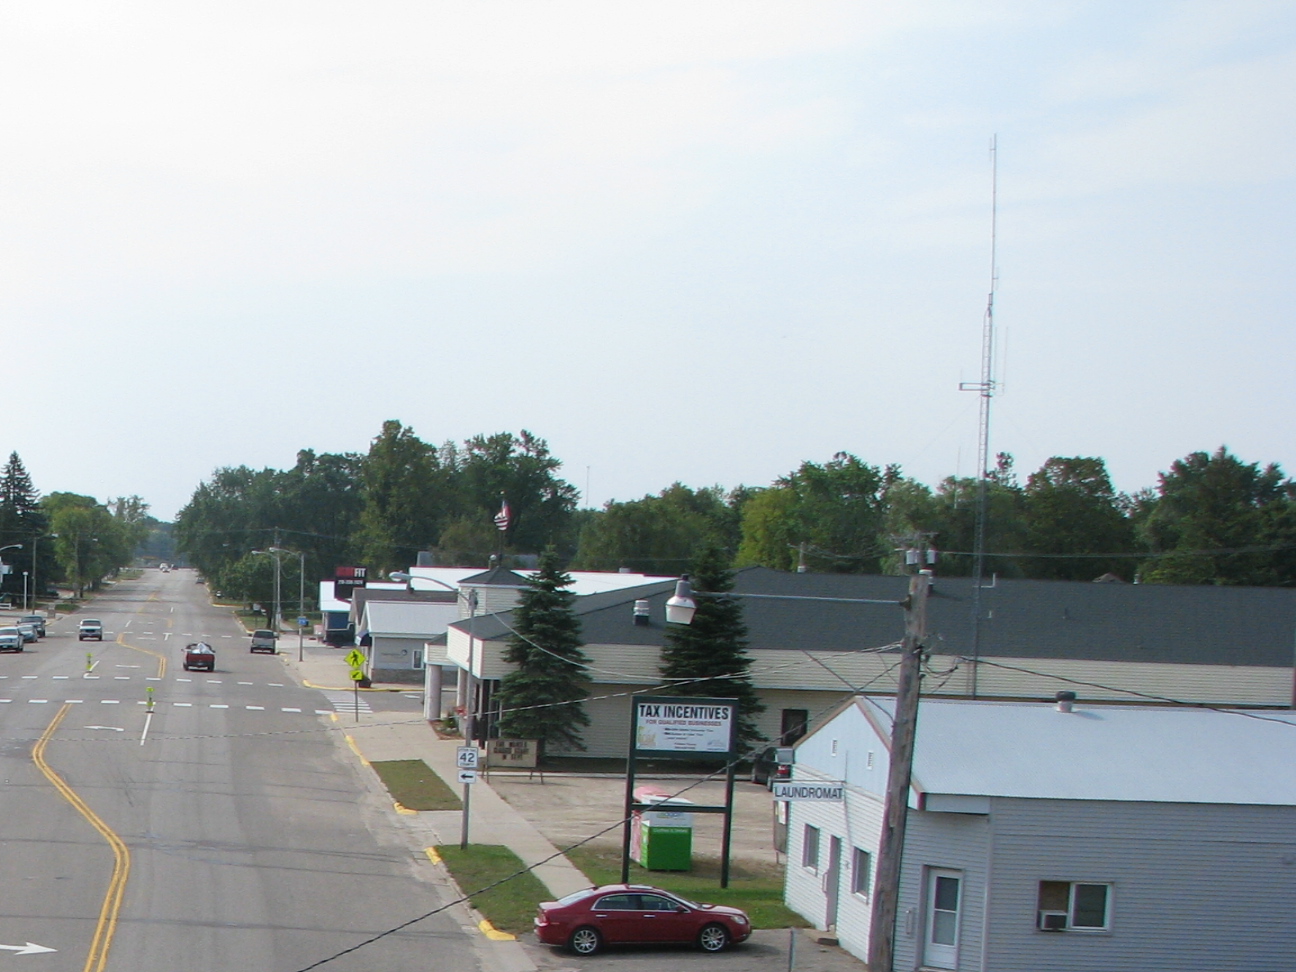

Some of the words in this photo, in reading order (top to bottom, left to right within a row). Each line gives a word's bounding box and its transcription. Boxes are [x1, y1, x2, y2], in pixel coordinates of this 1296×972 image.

[640, 704, 660, 718] TAX
[664, 705, 729, 720] INCENTIVES
[459, 752, 475, 763] 42
[775, 786, 843, 799] LAUNDROMAT
